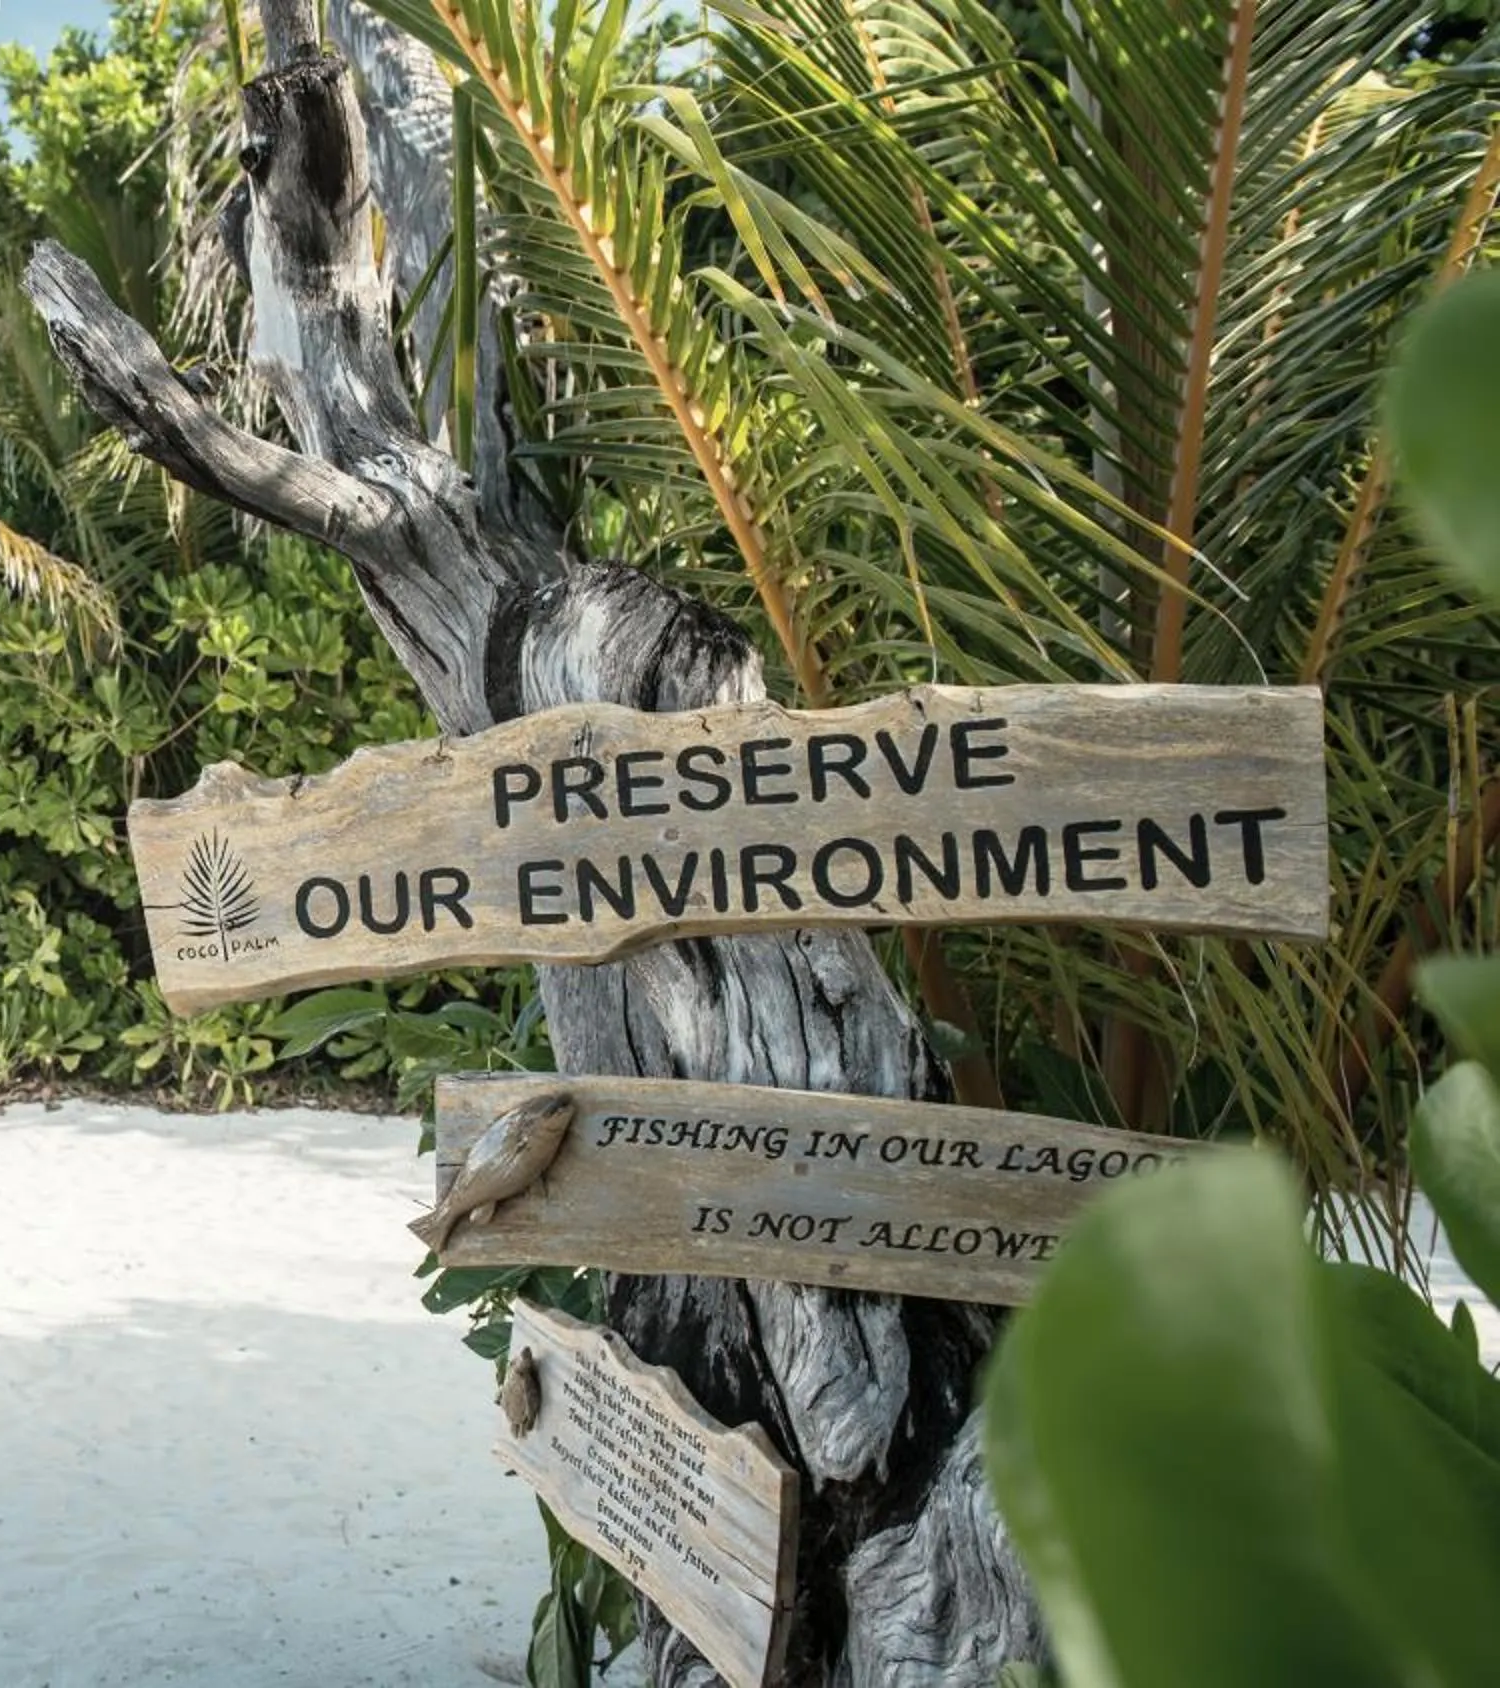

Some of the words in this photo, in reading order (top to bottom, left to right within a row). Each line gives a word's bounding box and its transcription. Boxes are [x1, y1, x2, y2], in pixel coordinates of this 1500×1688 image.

[493, 717, 1015, 829] PRESERVE
[296, 866, 473, 938] OUR
[517, 807, 1287, 925] ENVIRONMENT
[177, 944, 219, 961] COCO
[231, 936, 280, 953] PALM
[597, 1115, 790, 1158] FISHING
[803, 1130, 868, 1160] IN
[878, 1134, 983, 1169] OUR
[996, 1143, 1190, 1182] LAGOO
[691, 1207, 731, 1234] IS
[748, 1213, 853, 1244] NOT
[859, 1220, 1070, 1261] ALLOWE
[619, 1385, 640, 1407] often
[563, 1382, 593, 1415] Privacy
[649, 1447, 679, 1479] Please
[697, 1487, 714, 1505] not
[603, 1392, 626, 1417] their
[654, 1428, 675, 1457] They
[679, 1452, 704, 1476] need
[594, 1427, 615, 1451] them
[617, 1448, 627, 1463] or
[679, 1496, 707, 1527] when
[627, 1477, 650, 1500] their
[597, 1518, 624, 1553] Thank
[627, 1549, 645, 1571] you
[645, 1516, 666, 1538] and
[667, 1533, 681, 1554] the
[683, 1547, 719, 1584] future
